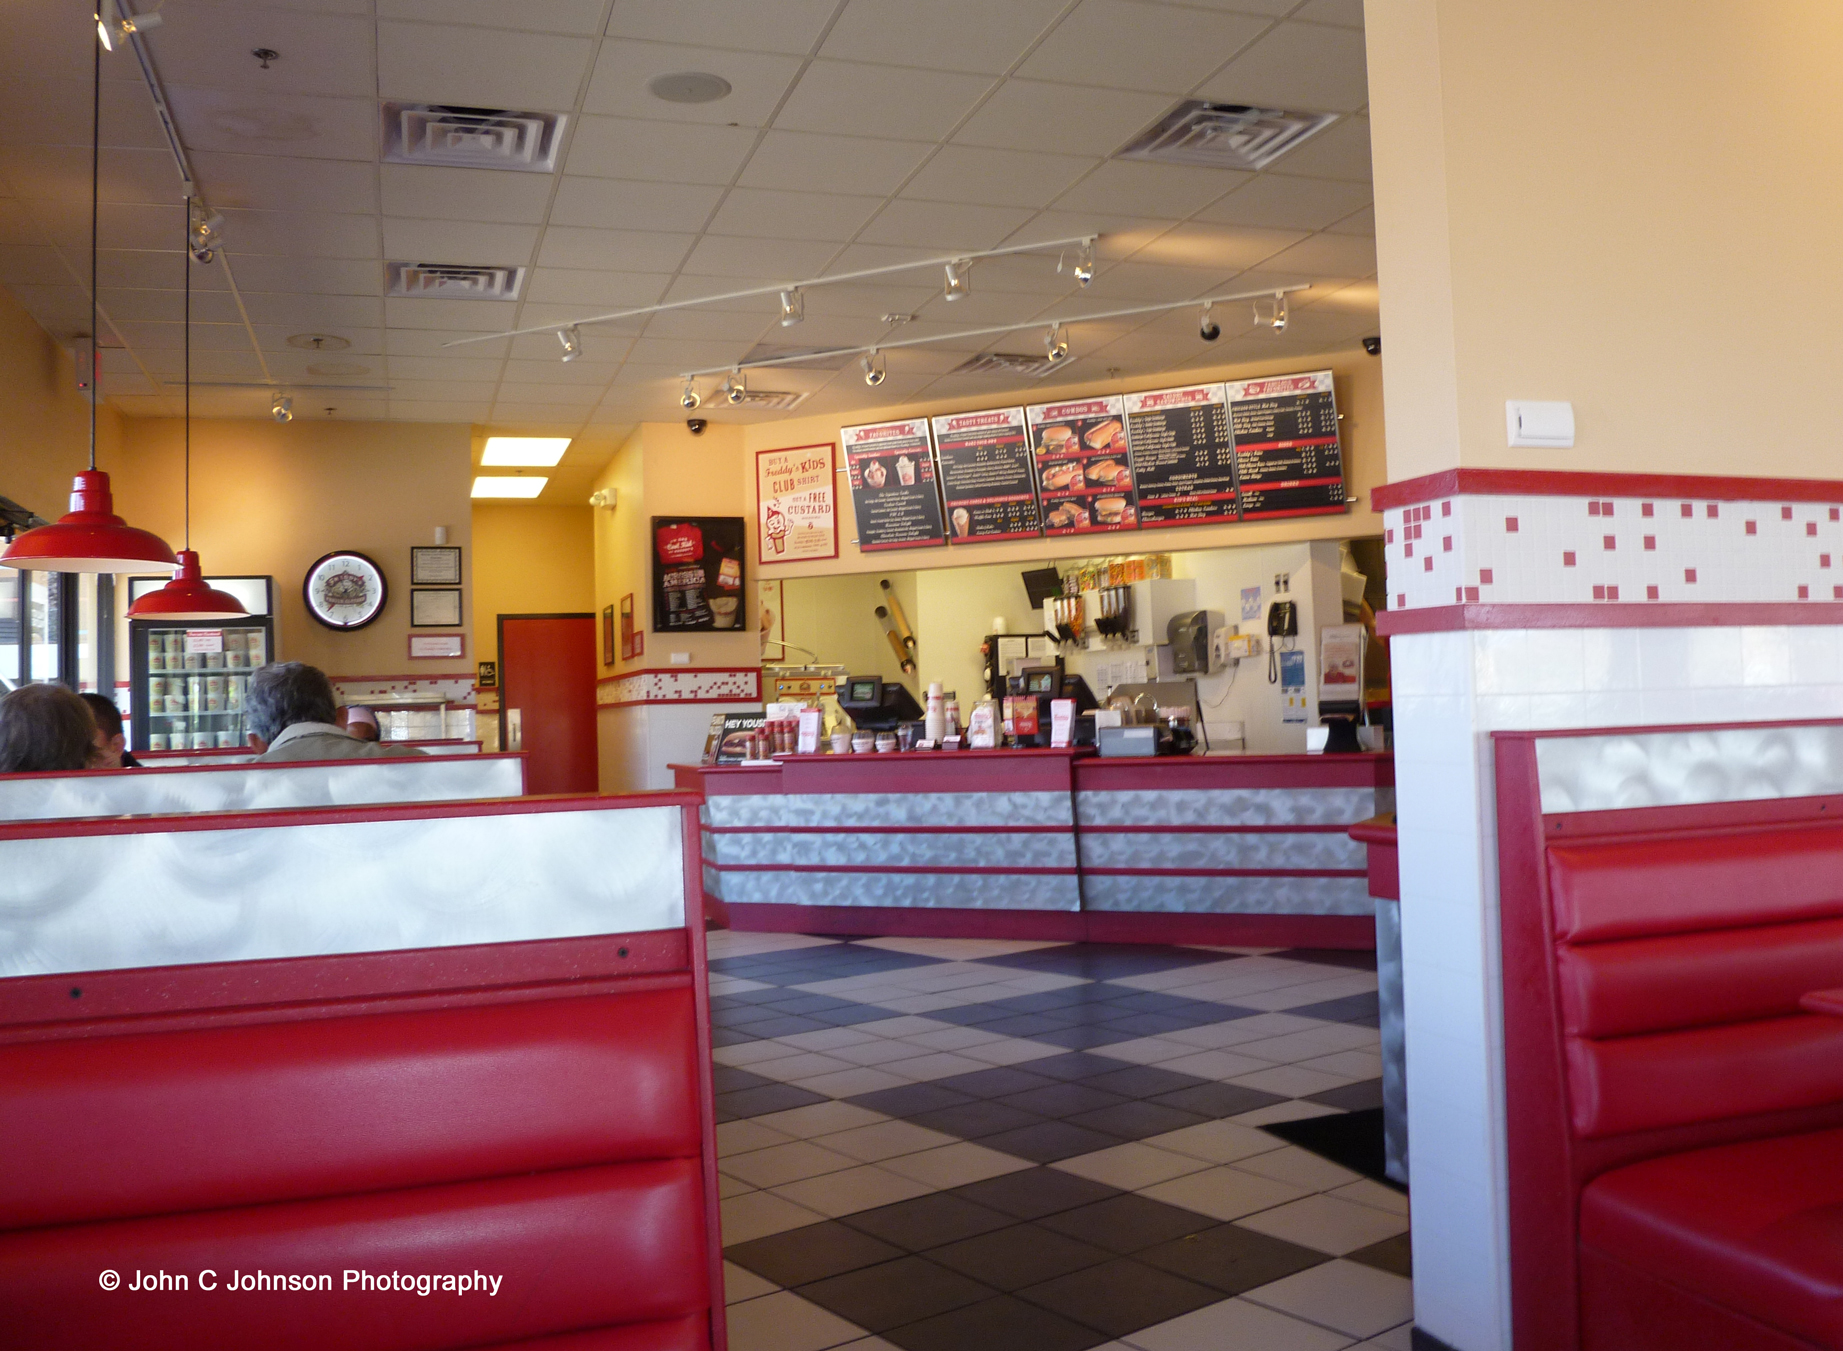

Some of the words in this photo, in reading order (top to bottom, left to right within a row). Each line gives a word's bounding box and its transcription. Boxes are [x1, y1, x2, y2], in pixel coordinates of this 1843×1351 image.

[768, 457, 782, 467] BUY
[784, 456, 788, 464] A
[765, 464, 800, 478] Freddy's
[800, 458, 826, 474] KIDS
[773, 478, 795, 494] CLUB
[797, 475, 820, 487] SHIRT
[808, 492, 826, 504] FREE
[787, 504, 832, 515] CUSTARD
[341, 560, 350, 568] 12
[724, 719, 742, 729] HEY
